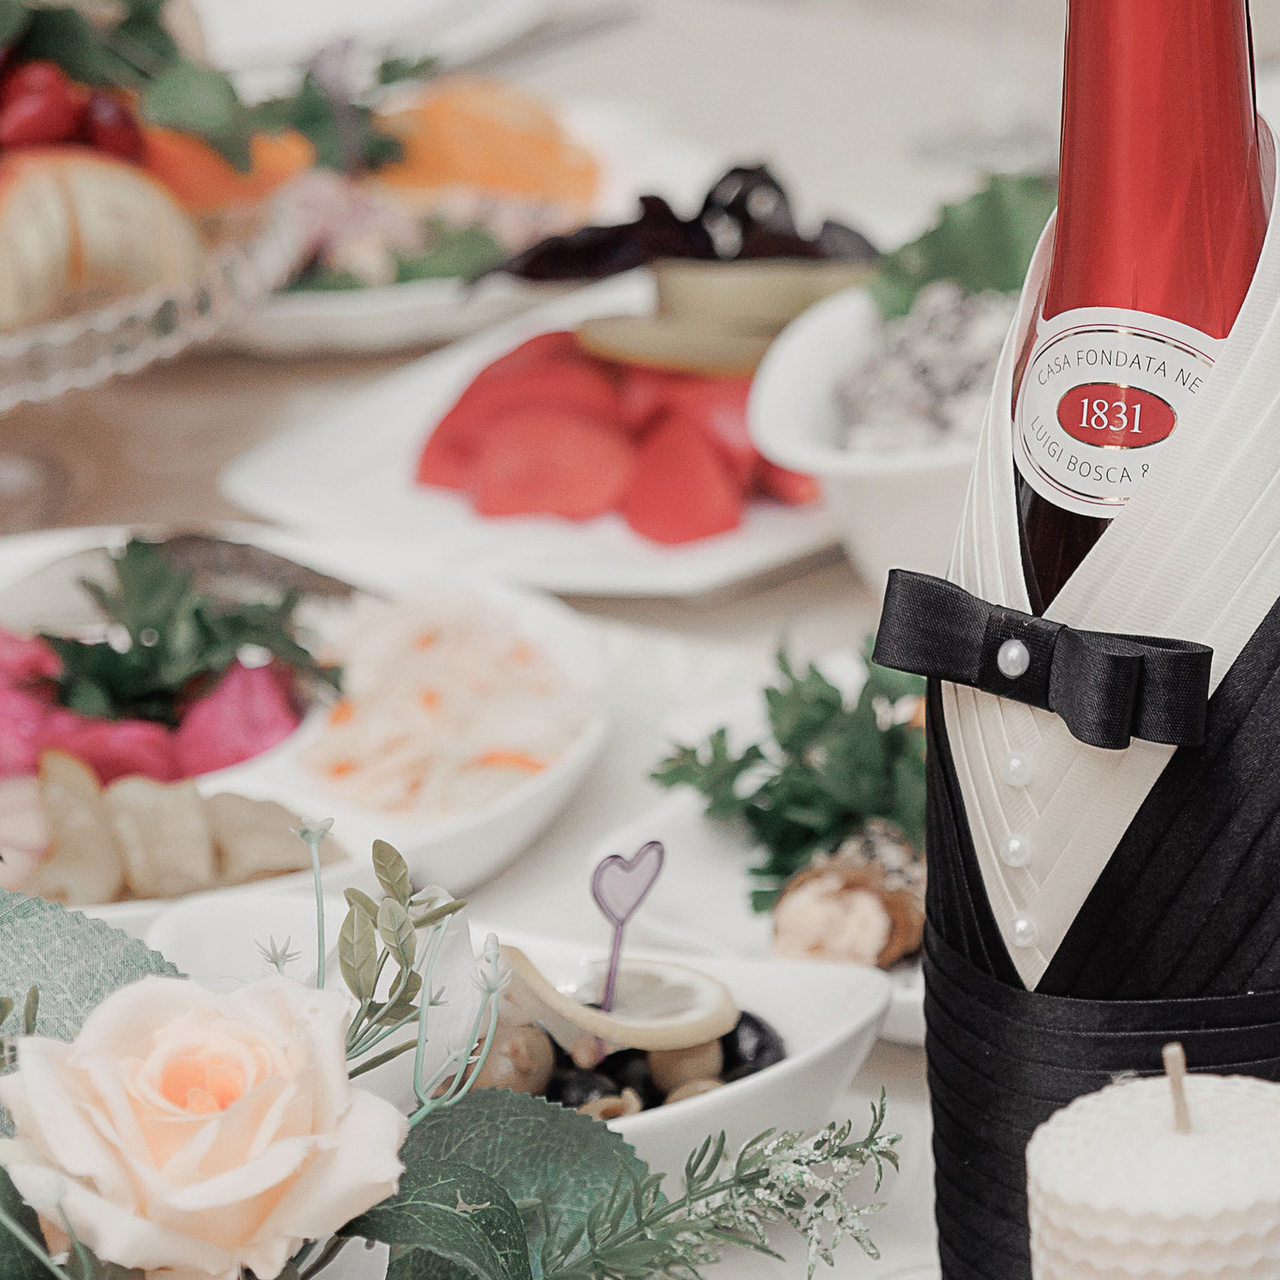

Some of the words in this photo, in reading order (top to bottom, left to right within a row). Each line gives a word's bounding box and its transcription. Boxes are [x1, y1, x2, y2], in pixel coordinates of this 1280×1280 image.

[1037, 354, 1071, 385] CASA
[1076, 349, 1167, 378] FONDATA
[1175, 368, 1203, 394] NE
[1078, 397, 1143, 433] 1831
[1030, 416, 1064, 462] LUIGI
[1066, 454, 1132, 483] BOSCA
